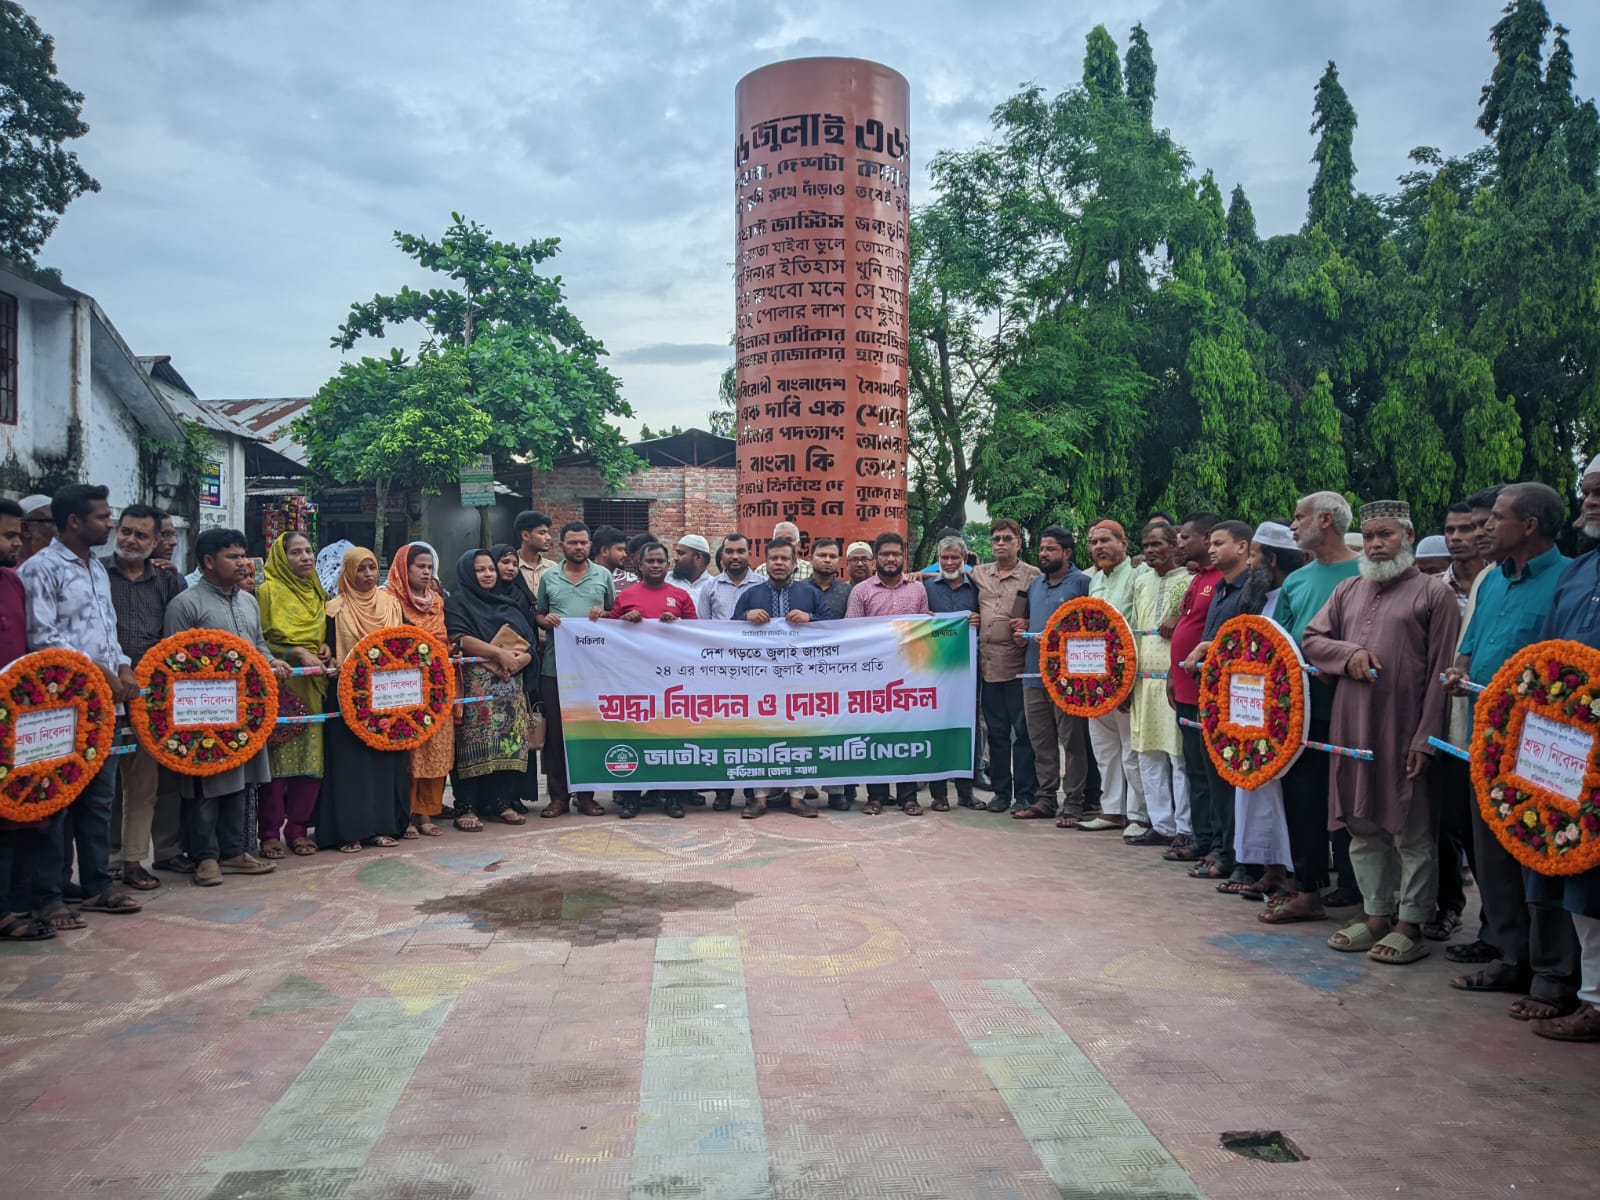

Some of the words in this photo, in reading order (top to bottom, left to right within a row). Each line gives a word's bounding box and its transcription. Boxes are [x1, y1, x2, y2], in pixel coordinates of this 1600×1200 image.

[751, 113, 845, 152] জুলাই
[778, 153, 845, 175] দেশটা
[769, 185, 797, 203] রুখে
[803, 178, 845, 199] দাঁড়াও
[771, 210, 845, 232] জাস্টিস
[814, 238, 846, 254] ভুলে
[856, 240, 894, 259] তোমরা
[779, 255, 846, 276] ইতিহাস
[856, 257, 883, 280] খুনি
[808, 281, 846, 297] মনে
[856, 283, 875, 299] সে
[756, 304, 806, 324] পোলার
[811, 303, 846, 318] লাশ
[855, 305, 873, 320] যে
[773, 325, 846, 345] অধিকার
[771, 347, 846, 366] রাজাকার
[856, 348, 884, 366] হয়ে
[777, 378, 846, 392] বাংলাদেশ
[741, 404, 760, 420] এক
[765, 394, 801, 418] দাবি
[809, 400, 846, 417] এক
[779, 425, 846, 441] পদত্যাগ
[750, 453, 796, 475] বাংলা
[805, 444, 835, 473] কি
[825, 480, 845, 492] দে
[856, 485, 891, 503] বুকের
[743, 498, 779, 519] কোটা
[782, 496, 817, 522] তুই
[821, 500, 845, 516] নে
[856, 503, 882, 522] বুক
[701, 648, 723, 659] দেশ
[728, 648, 762, 661] গড়তে
[766, 644, 799, 661] জুলাই
[802, 643, 841, 658] জাগরণ
[656, 665, 672, 678] ২৪
[678, 665, 695, 677] এর
[772, 662, 804, 678] জুলাই
[807, 659, 857, 675] শহীদদের
[861, 657, 885, 673] প্রতি
[599, 694, 656, 722] শ্রদ্ধা
[664, 684, 749, 722] নিবেদন
[758, 693, 777, 717] ও
[785, 692, 839, 721] দোয়া
[848, 678, 938, 714] মাহফিল
[643, 743, 718, 767] জাতীয়
[723, 741, 813, 766] নাগরিক
[726, 764, 766, 780] কুড়িগ্রাম
[767, 766, 792, 776] জেলা
[794, 765, 818, 775] শাখা
